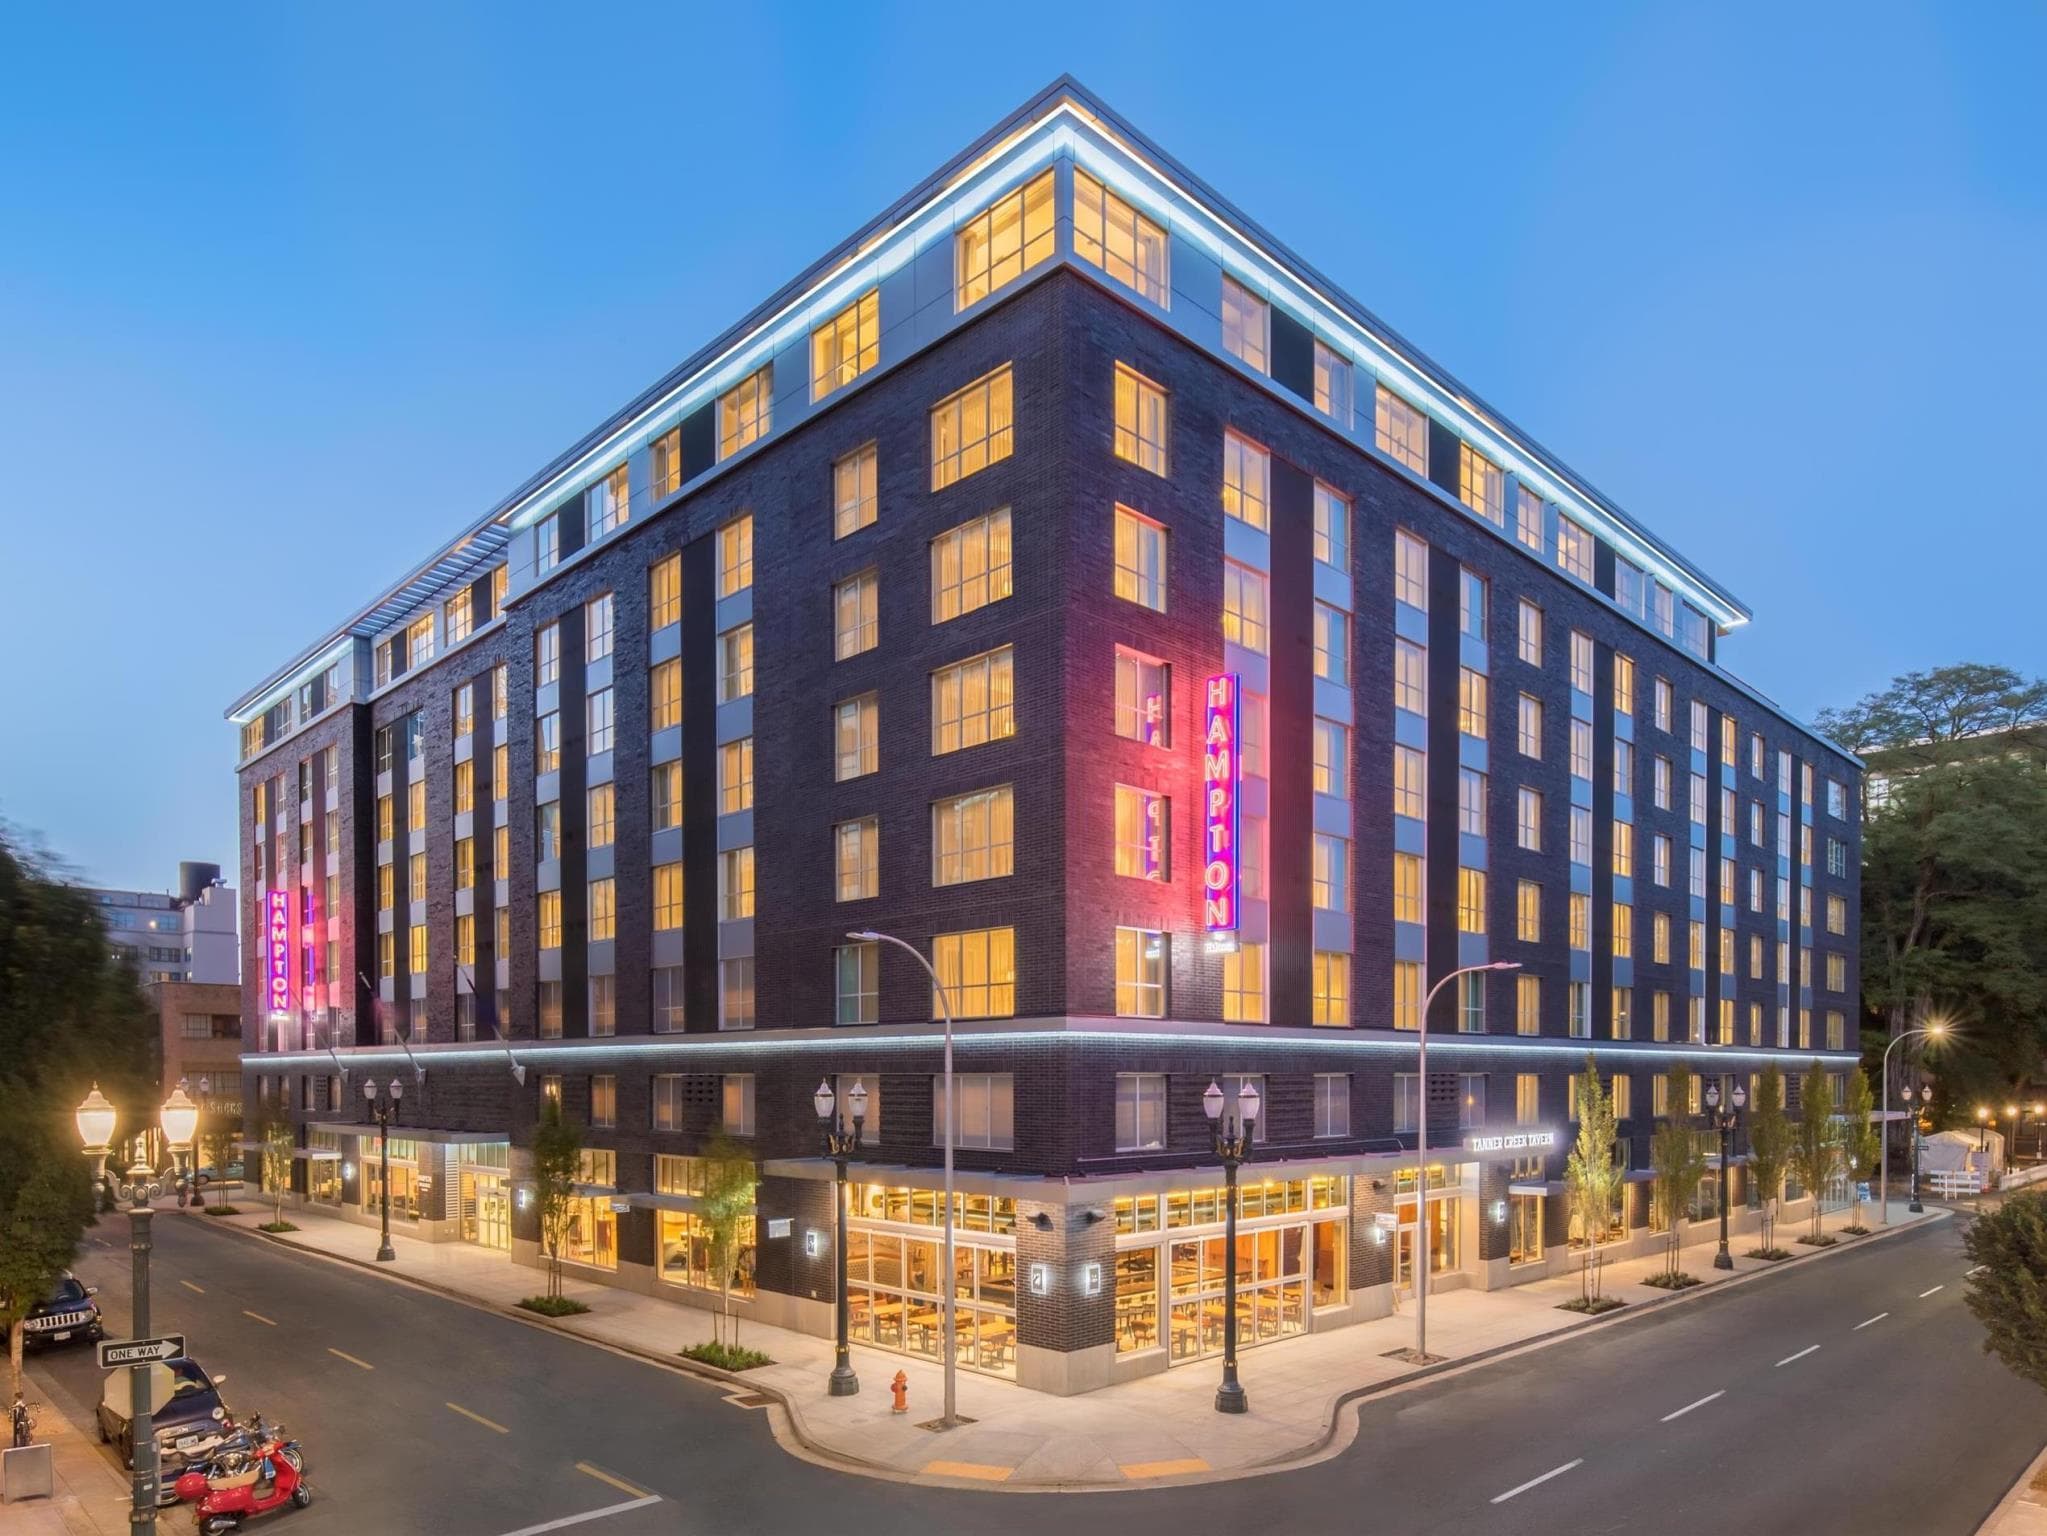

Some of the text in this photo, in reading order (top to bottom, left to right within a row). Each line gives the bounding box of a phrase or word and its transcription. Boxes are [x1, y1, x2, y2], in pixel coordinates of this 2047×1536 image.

[1204, 677, 1230, 926] HAMPTON
[271, 892, 288, 1009] HAMPTON
[1472, 1132, 1554, 1151] TANNER CREEK TAVERN
[110, 1345, 160, 1360] ONE WAY
